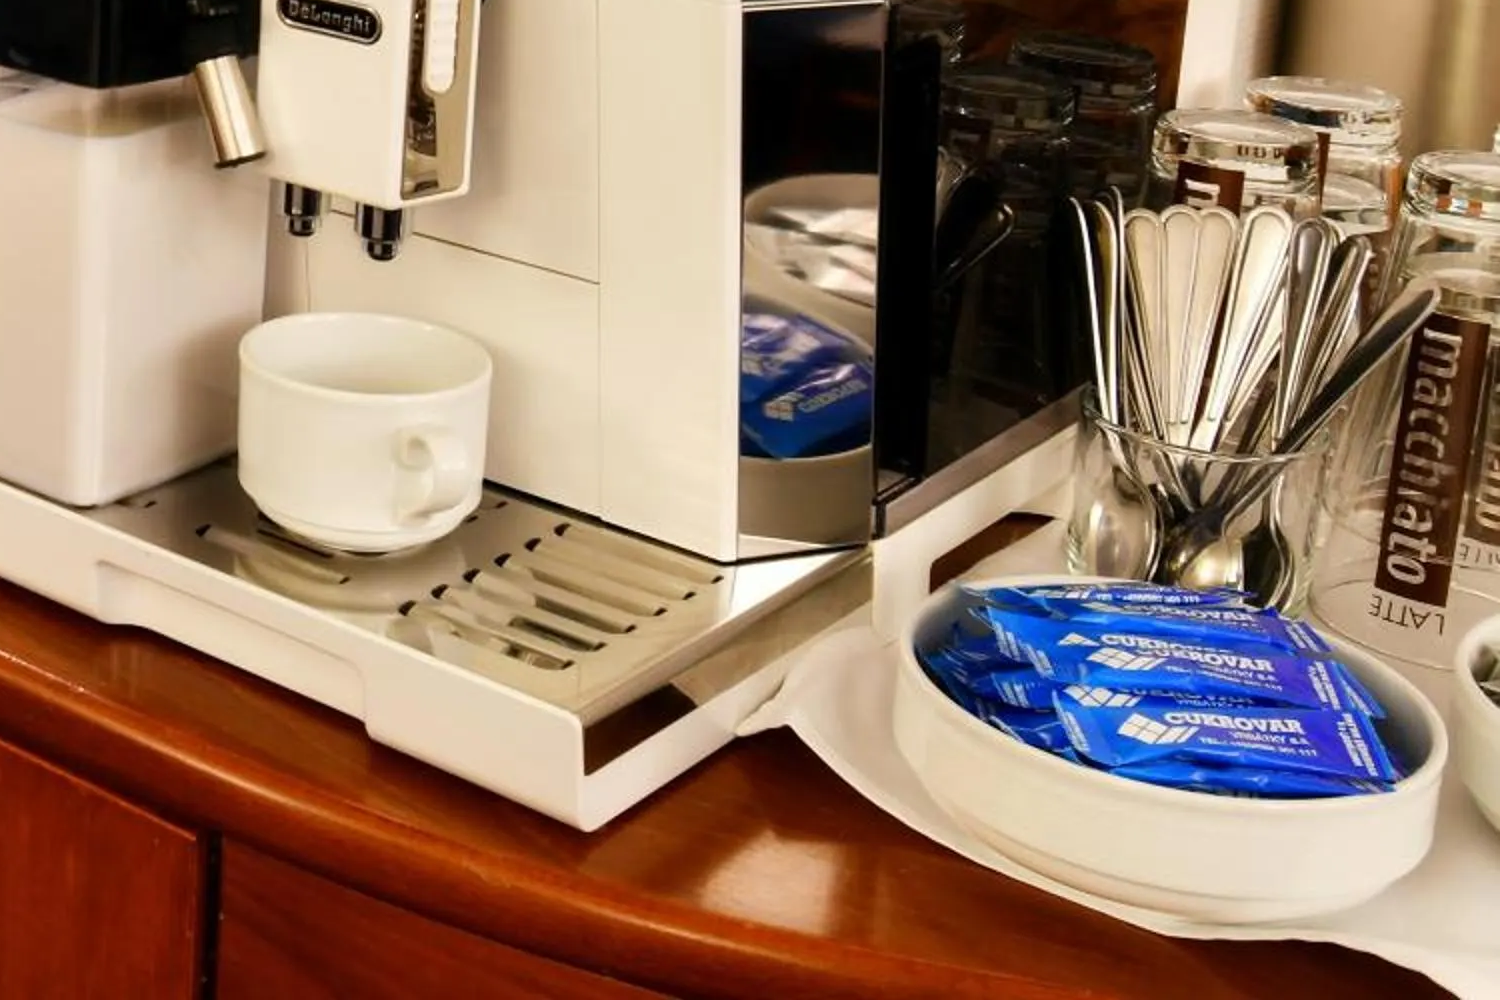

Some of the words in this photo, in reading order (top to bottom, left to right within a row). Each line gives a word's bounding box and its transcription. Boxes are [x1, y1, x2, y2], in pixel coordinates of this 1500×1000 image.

[1386, 327, 1463, 587] macchiato
[1368, 594, 1446, 636] LATTE
[1164, 711, 1307, 736] CUKROVAR
